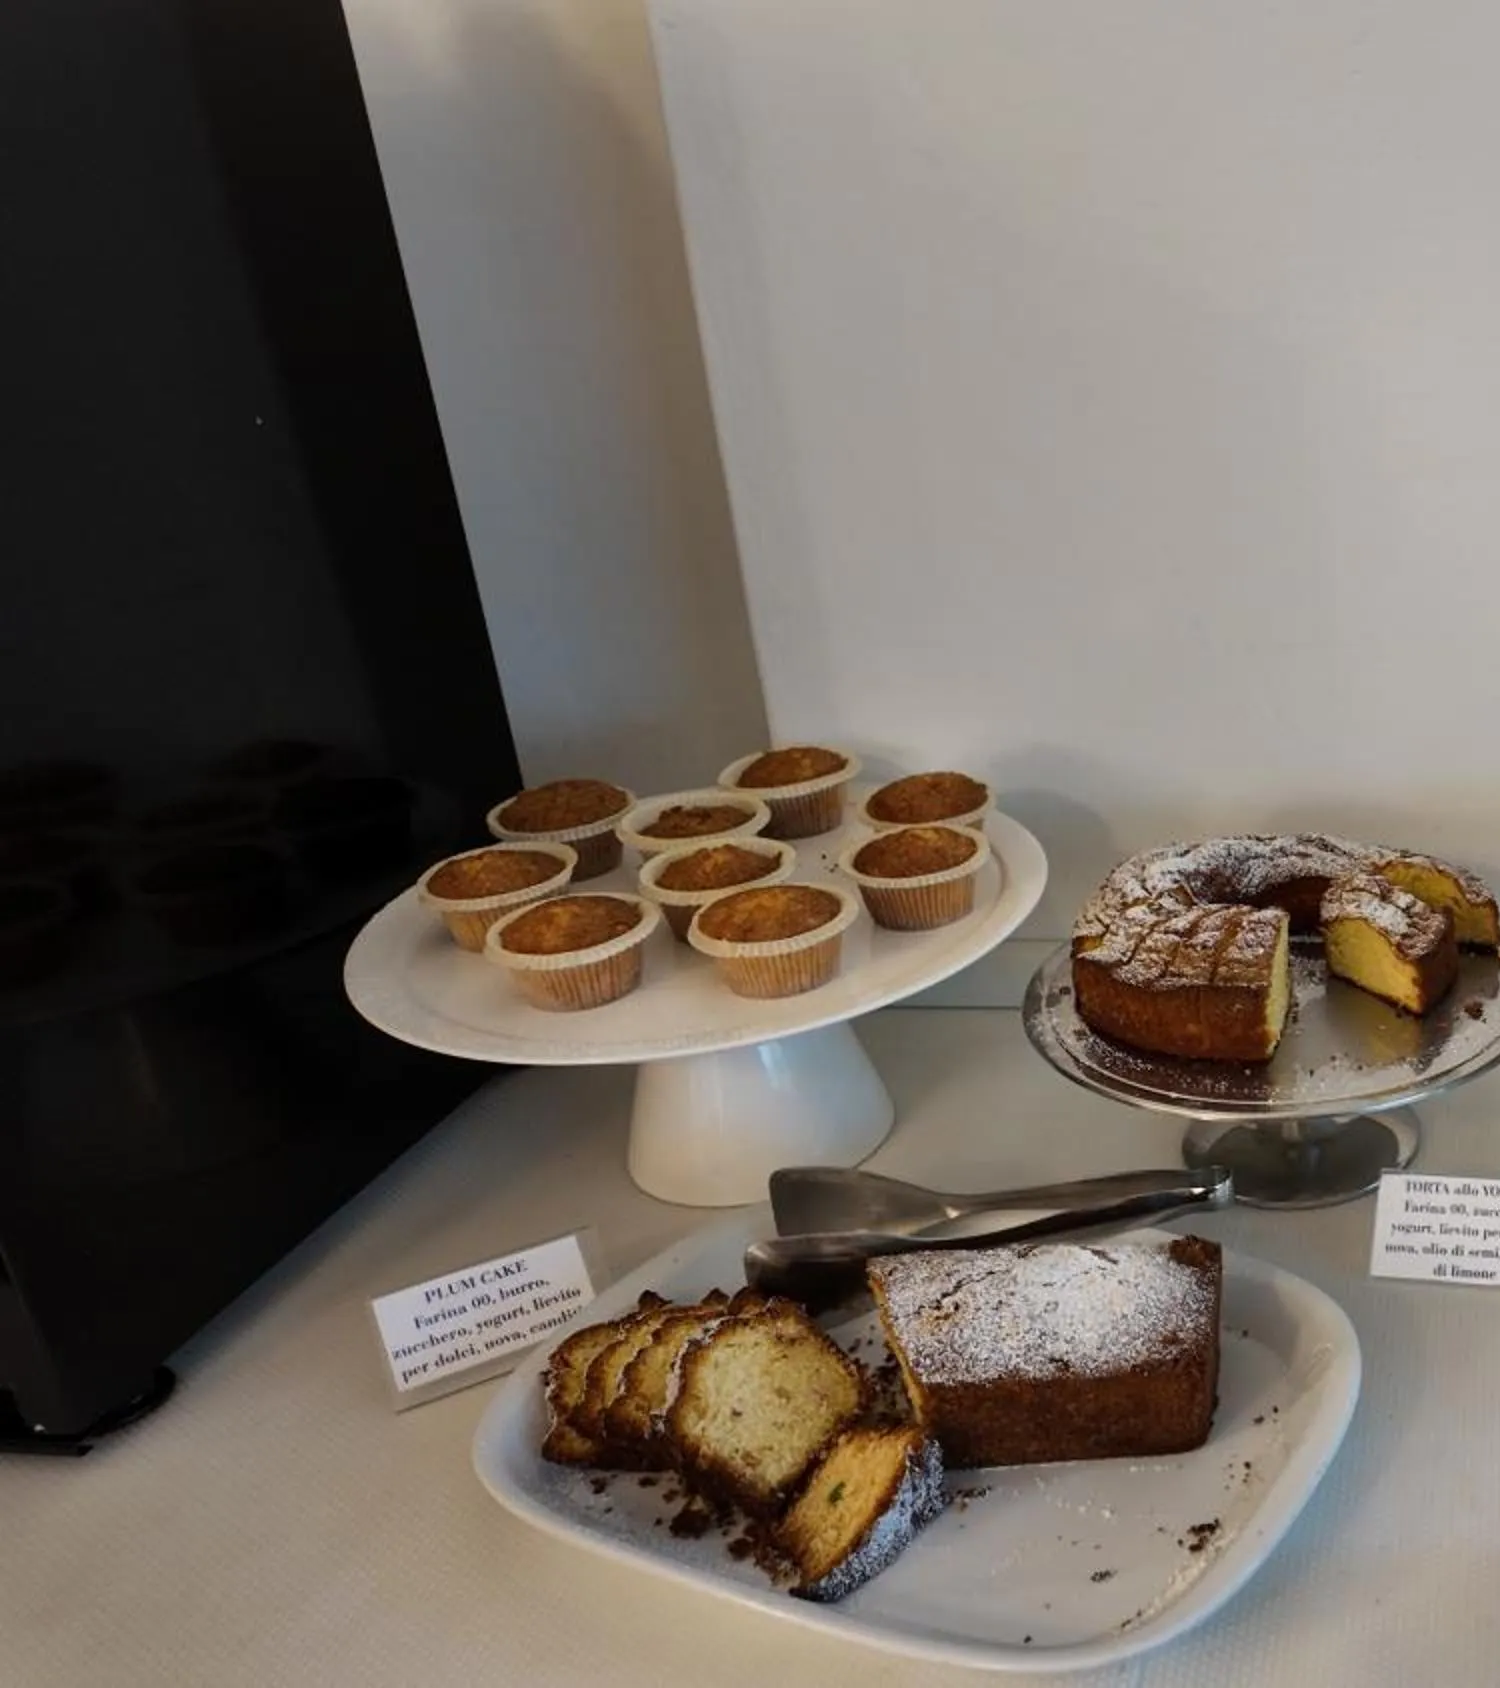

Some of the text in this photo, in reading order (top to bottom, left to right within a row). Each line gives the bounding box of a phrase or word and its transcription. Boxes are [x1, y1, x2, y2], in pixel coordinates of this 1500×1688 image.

[1404, 1179, 1450, 1196] TORTA
[1453, 1182, 1480, 1197] allo
[1403, 1200, 1447, 1215] Farina
[1448, 1203, 1470, 1218] 00,
[1390, 1222, 1436, 1239] yogurt,
[1438, 1222, 1480, 1238] lievito
[1421, 1241, 1448, 1257] olio
[1450, 1244, 1466, 1258] di
[423, 1257, 529, 1305] PLUM CAKE
[1432, 1263, 1498, 1281] di limone
[412, 1276, 551, 1331] Farina 00, burro,
[391, 1285, 582, 1362] zucchero, yogurt, lievito
[400, 1304, 584, 1385] per dolci, uova, candi
